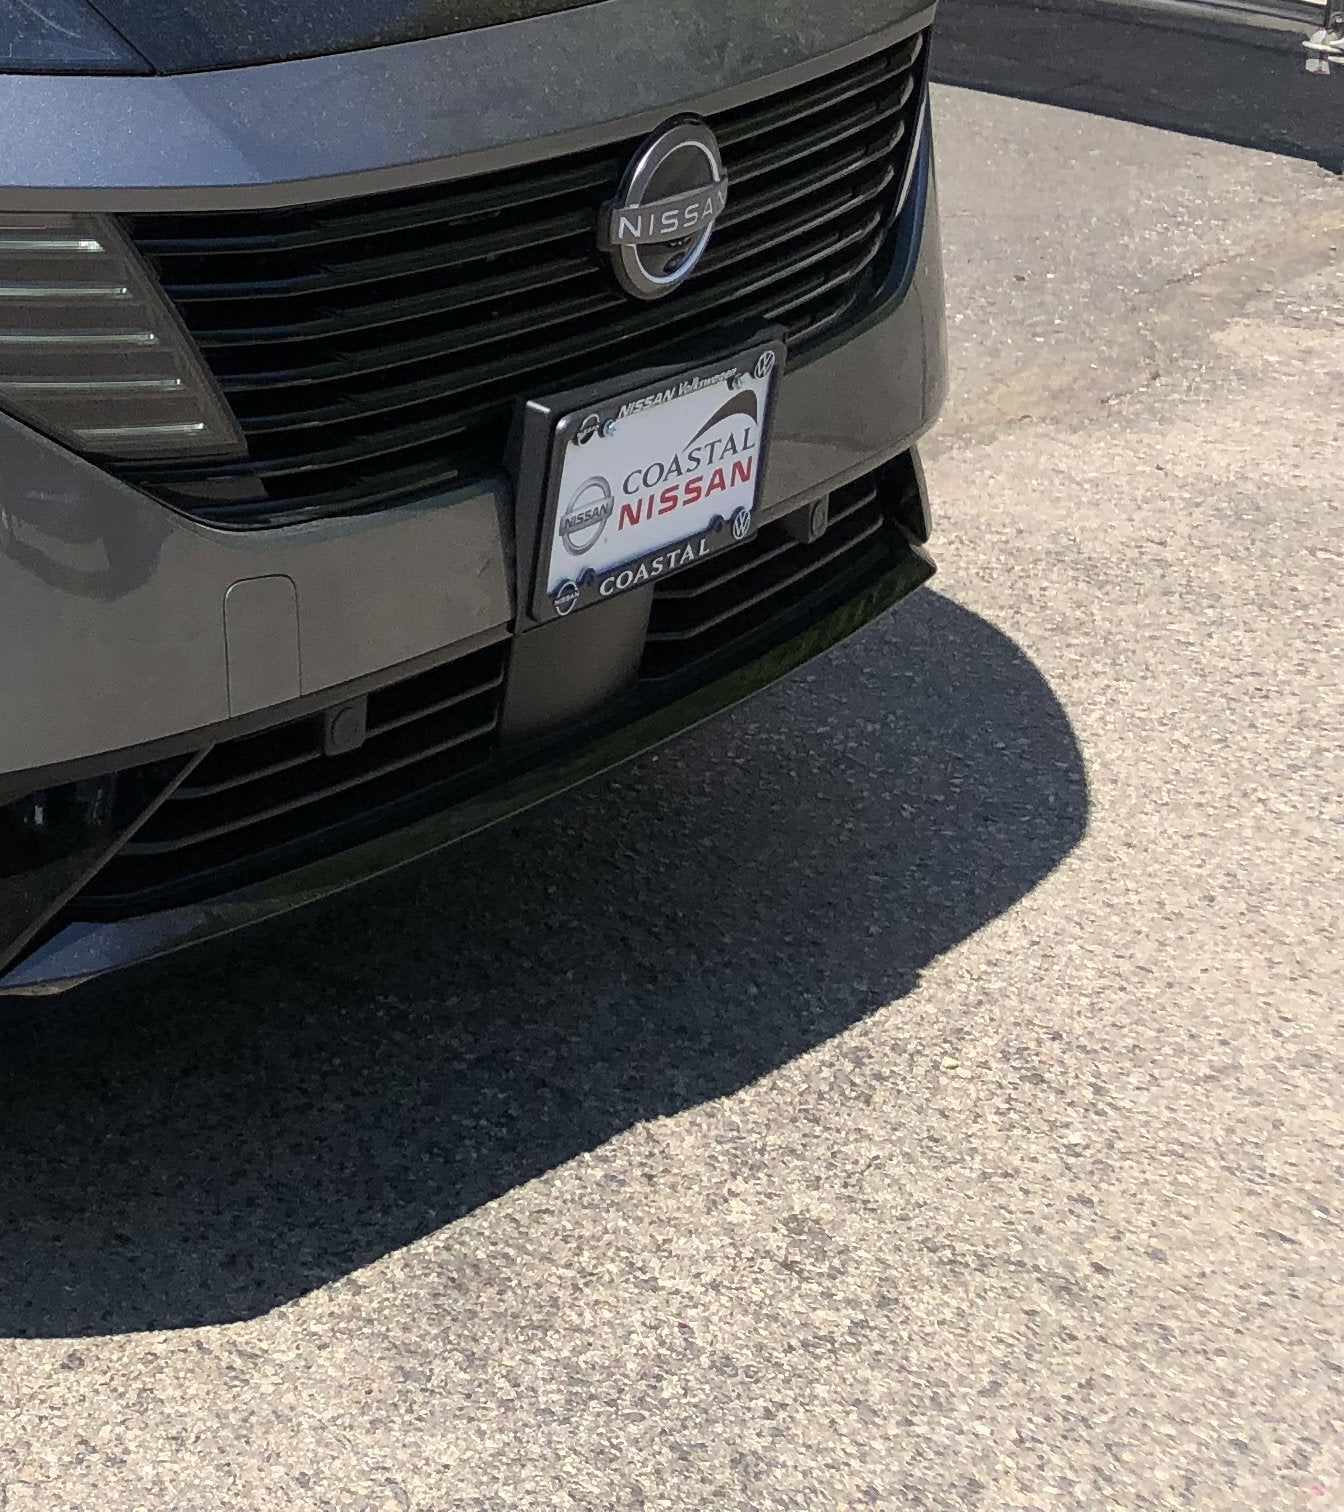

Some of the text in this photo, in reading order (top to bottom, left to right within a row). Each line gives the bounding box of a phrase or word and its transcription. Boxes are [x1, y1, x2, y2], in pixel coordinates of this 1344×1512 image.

[618, 386, 676, 419] NISSAN
[622, 426, 756, 495] COASTAL
[564, 501, 609, 529] NISSAN
[617, 455, 753, 531] NISSAN
[599, 538, 711, 596] COASTAL
